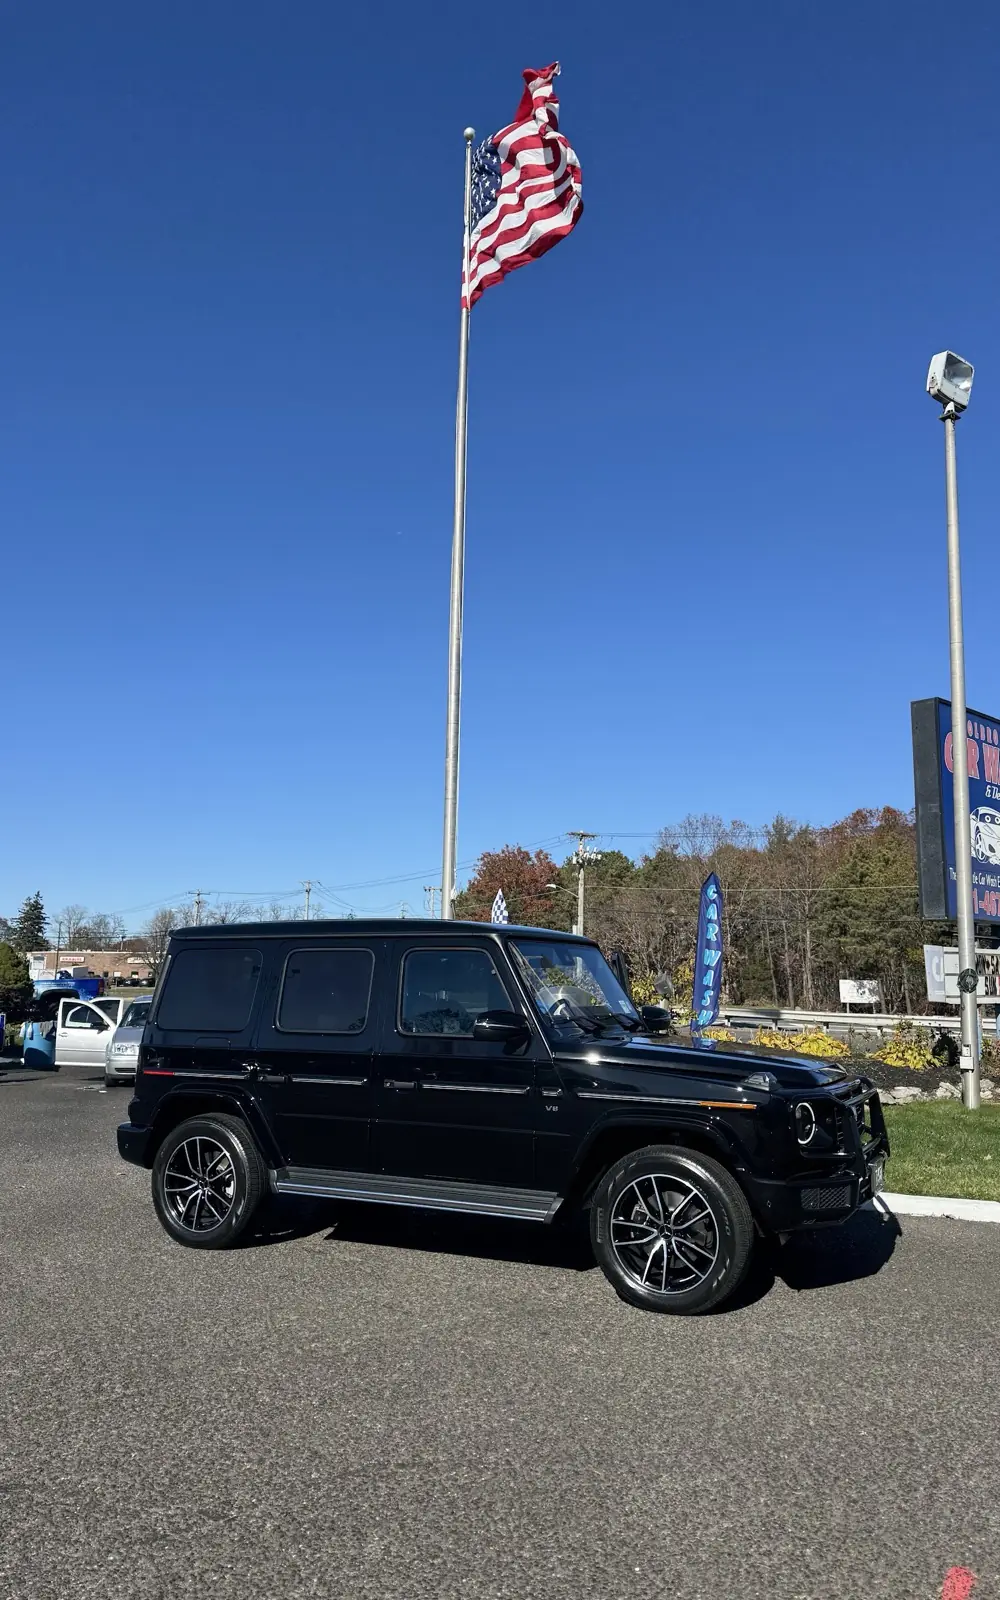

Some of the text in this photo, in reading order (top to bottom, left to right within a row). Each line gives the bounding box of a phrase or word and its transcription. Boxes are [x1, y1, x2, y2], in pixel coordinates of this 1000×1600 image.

[944, 731, 1000, 785] CR W
[967, 720, 999, 746] OLBRO
[698, 885, 722, 1025] CAR WASH
